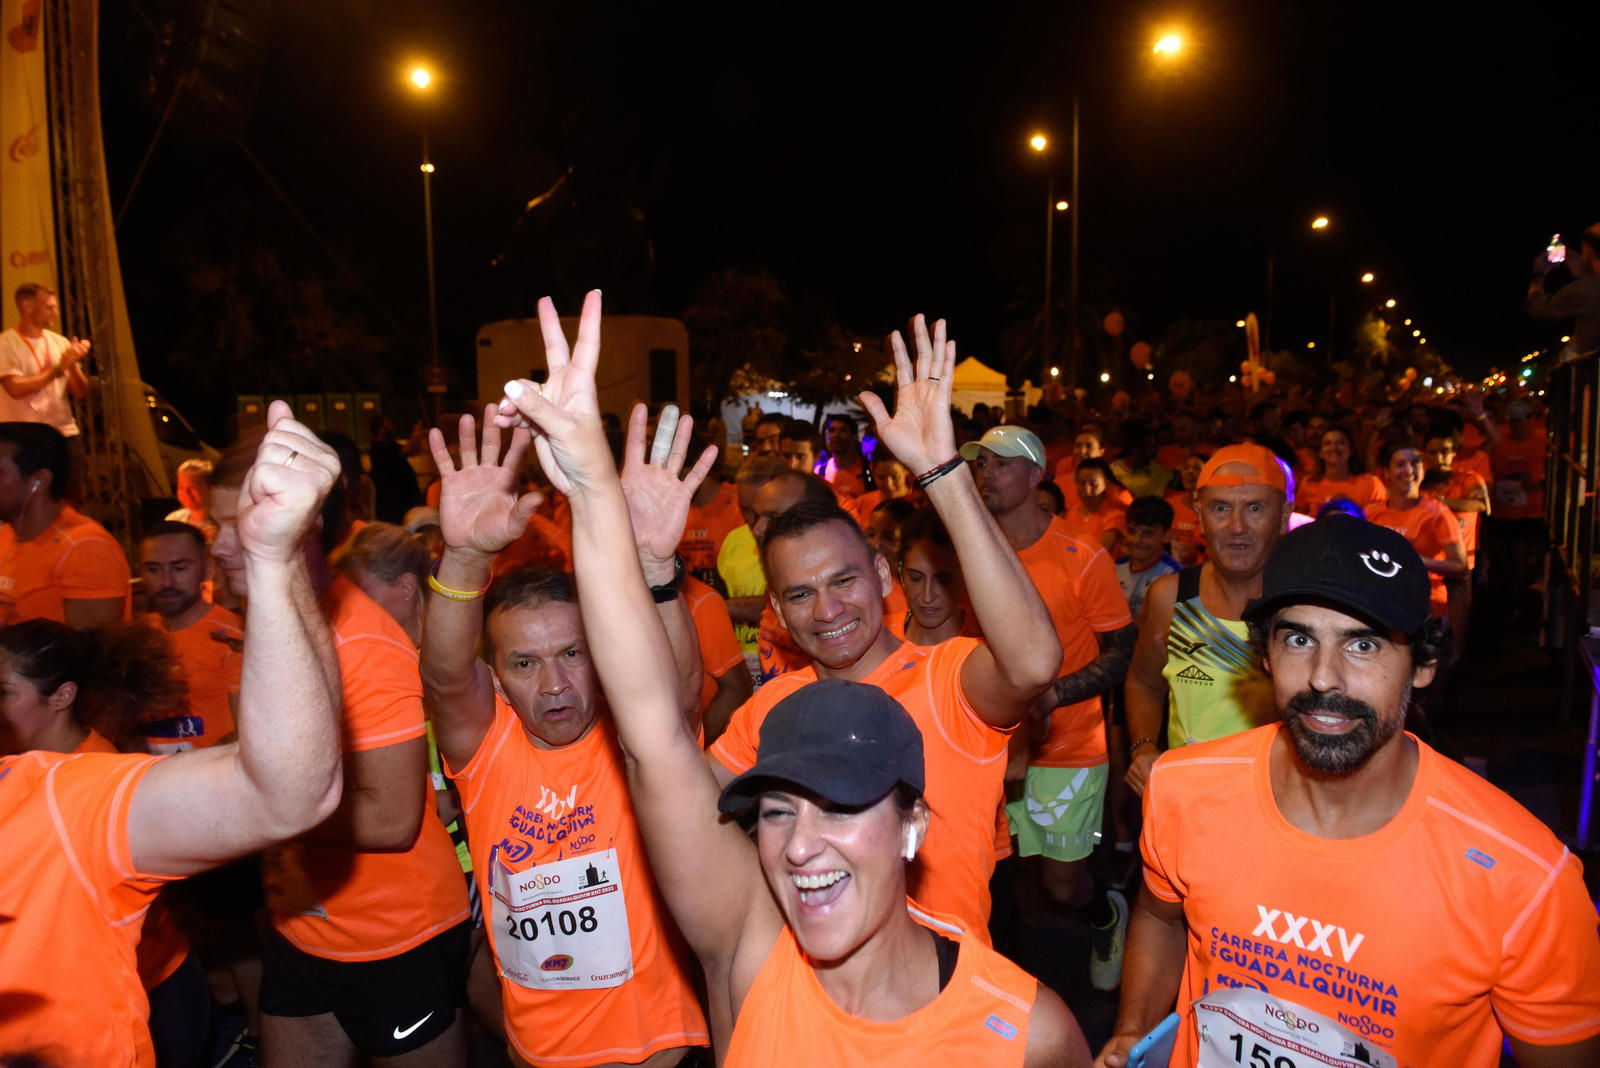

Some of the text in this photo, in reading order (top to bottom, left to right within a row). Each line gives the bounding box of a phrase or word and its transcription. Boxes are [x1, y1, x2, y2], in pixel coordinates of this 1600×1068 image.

[1046, 829, 1092, 848] NIKE
[552, 891, 591, 904] GUADALQUIVIR
[506, 906, 598, 941] 20108
[1251, 904, 1365, 964] XXXV
[1210, 940, 1218, 958] DEL
[1211, 927, 1399, 998] CARRERA NOCTURNA
[545, 959, 568, 969] KH7
[590, 968, 629, 982] Cruzcampo
[1219, 947, 1397, 1018] GUADALQUIVIR
[1223, 1009, 1250, 1029] CARRERA
[1250, 1024, 1287, 1047] NOCTURNA
[1287, 1042, 1300, 1052] DEL
[1300, 1047, 1355, 1068] GUADALQUIVIR
